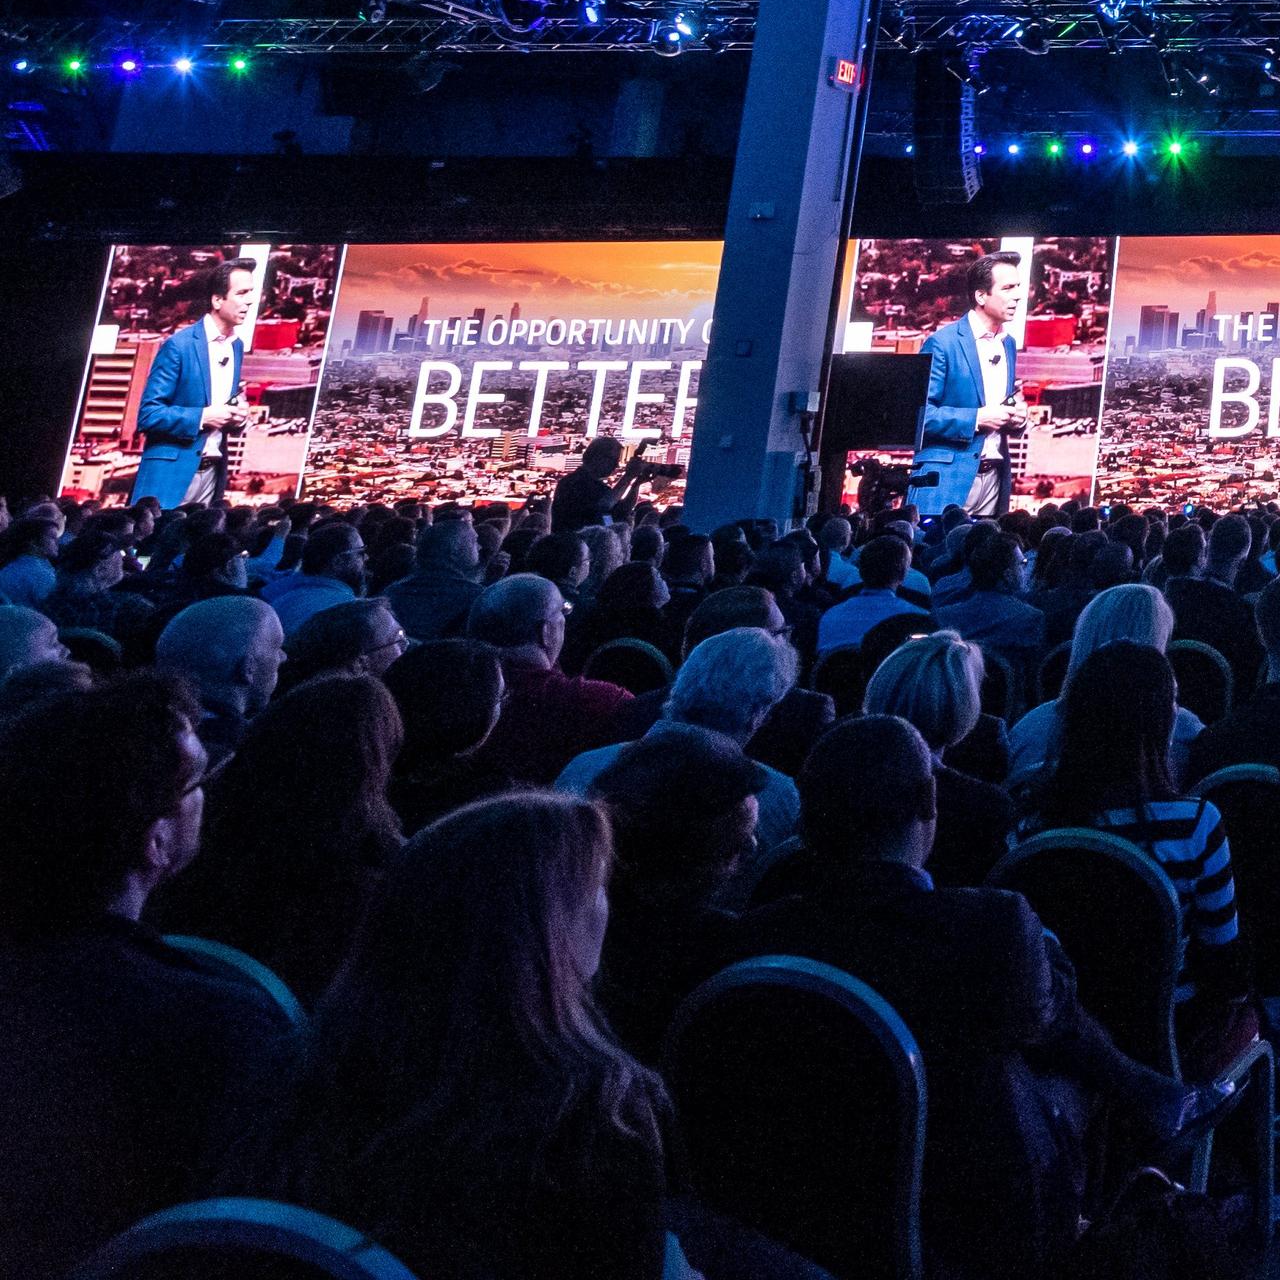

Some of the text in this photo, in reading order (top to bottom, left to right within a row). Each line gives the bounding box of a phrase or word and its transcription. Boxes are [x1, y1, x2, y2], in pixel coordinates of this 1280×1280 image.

[837, 60, 856, 84] EXIT
[424, 319, 480, 346] THE
[487, 318, 696, 346] OPPORTUNITY
[1213, 313, 1275, 342] THE
